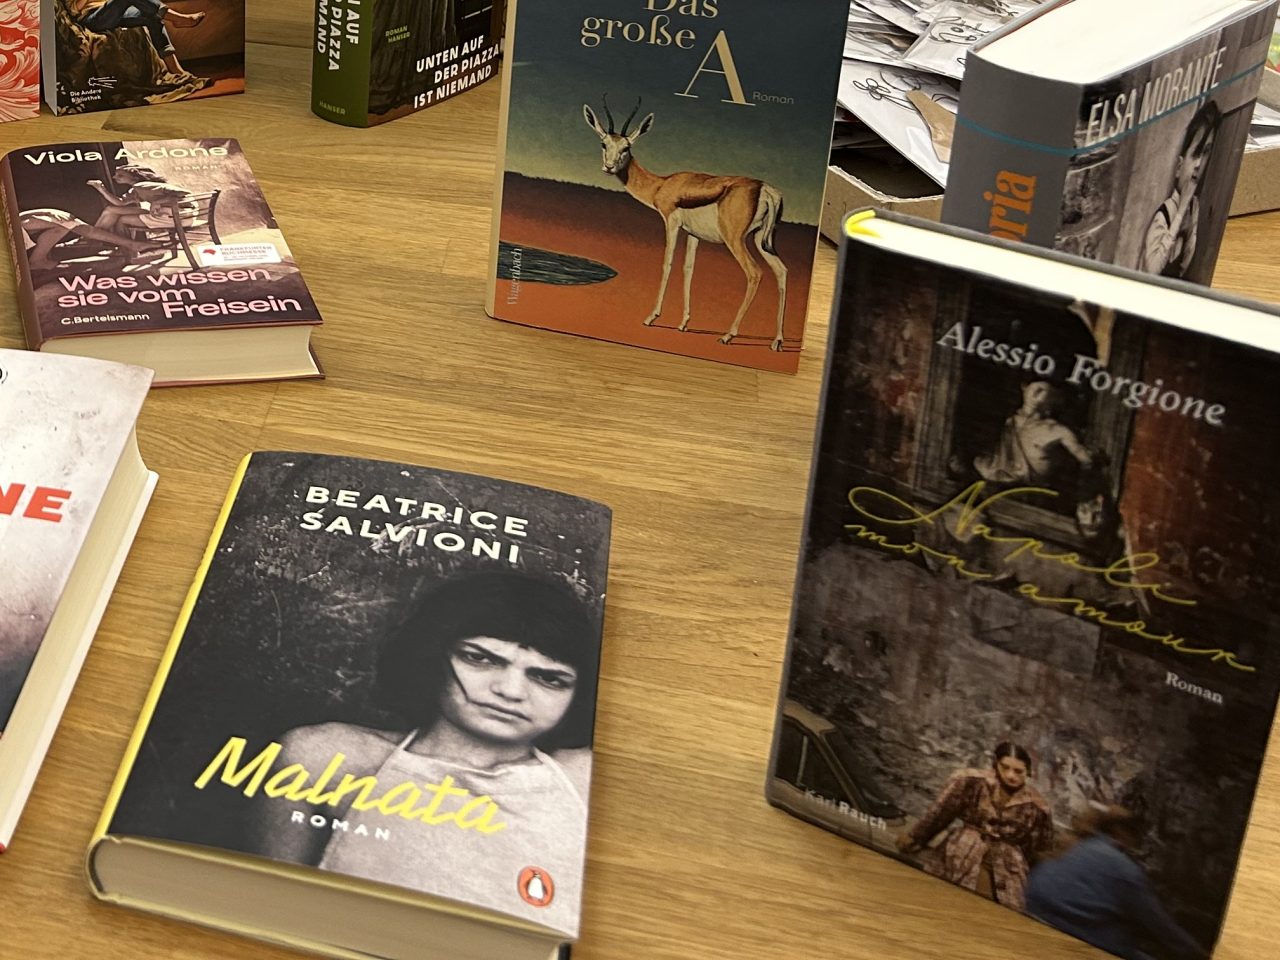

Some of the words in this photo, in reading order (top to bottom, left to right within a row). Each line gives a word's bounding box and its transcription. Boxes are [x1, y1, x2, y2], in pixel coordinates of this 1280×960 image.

[327, 5, 343, 71] PIAZZA
[345, 12, 362, 45] AUF
[385, 25, 408, 38] ROMAN
[387, 31, 411, 43] HANSER
[580, 14, 697, 49] große
[415, 47, 459, 74] UNTEN
[460, 34, 485, 58] AUF
[433, 62, 458, 85] DER
[460, 44, 499, 76] PIAZZA
[673, 29, 756, 107] A
[71, 94, 102, 103] Bibliothek
[80, 89, 102, 97] Andere
[413, 87, 434, 110] IST
[435, 64, 492, 103] NIEMAND
[752, 91, 795, 105] Roman
[1086, 88, 1138, 147] ELSA
[1138, 46, 1227, 124] MORANTE
[24, 150, 103, 166] Viola
[114, 145, 229, 162] Ardone
[58, 272, 138, 292] Was
[146, 267, 272, 286] wissen
[57, 290, 109, 309] sie
[118, 288, 196, 304] vom
[161, 295, 302, 319] Freisein
[60, 312, 151, 326] C.Bertelsmann
[936, 321, 1056, 377] Alessio
[1067, 353, 1227, 427] Forgione
[305, 485, 530, 538] BEATRICE
[299, 510, 521, 564] SALVIONI
[847, 481, 1197, 605] Napoli
[843, 524, 994, 579] mon
[1019, 582, 1256, 672] amour
[1165, 671, 1225, 704] Roman
[194, 736, 508, 835] Malnata
[291, 809, 391, 841] ROMAN
[839, 800, 888, 831] Rauch
